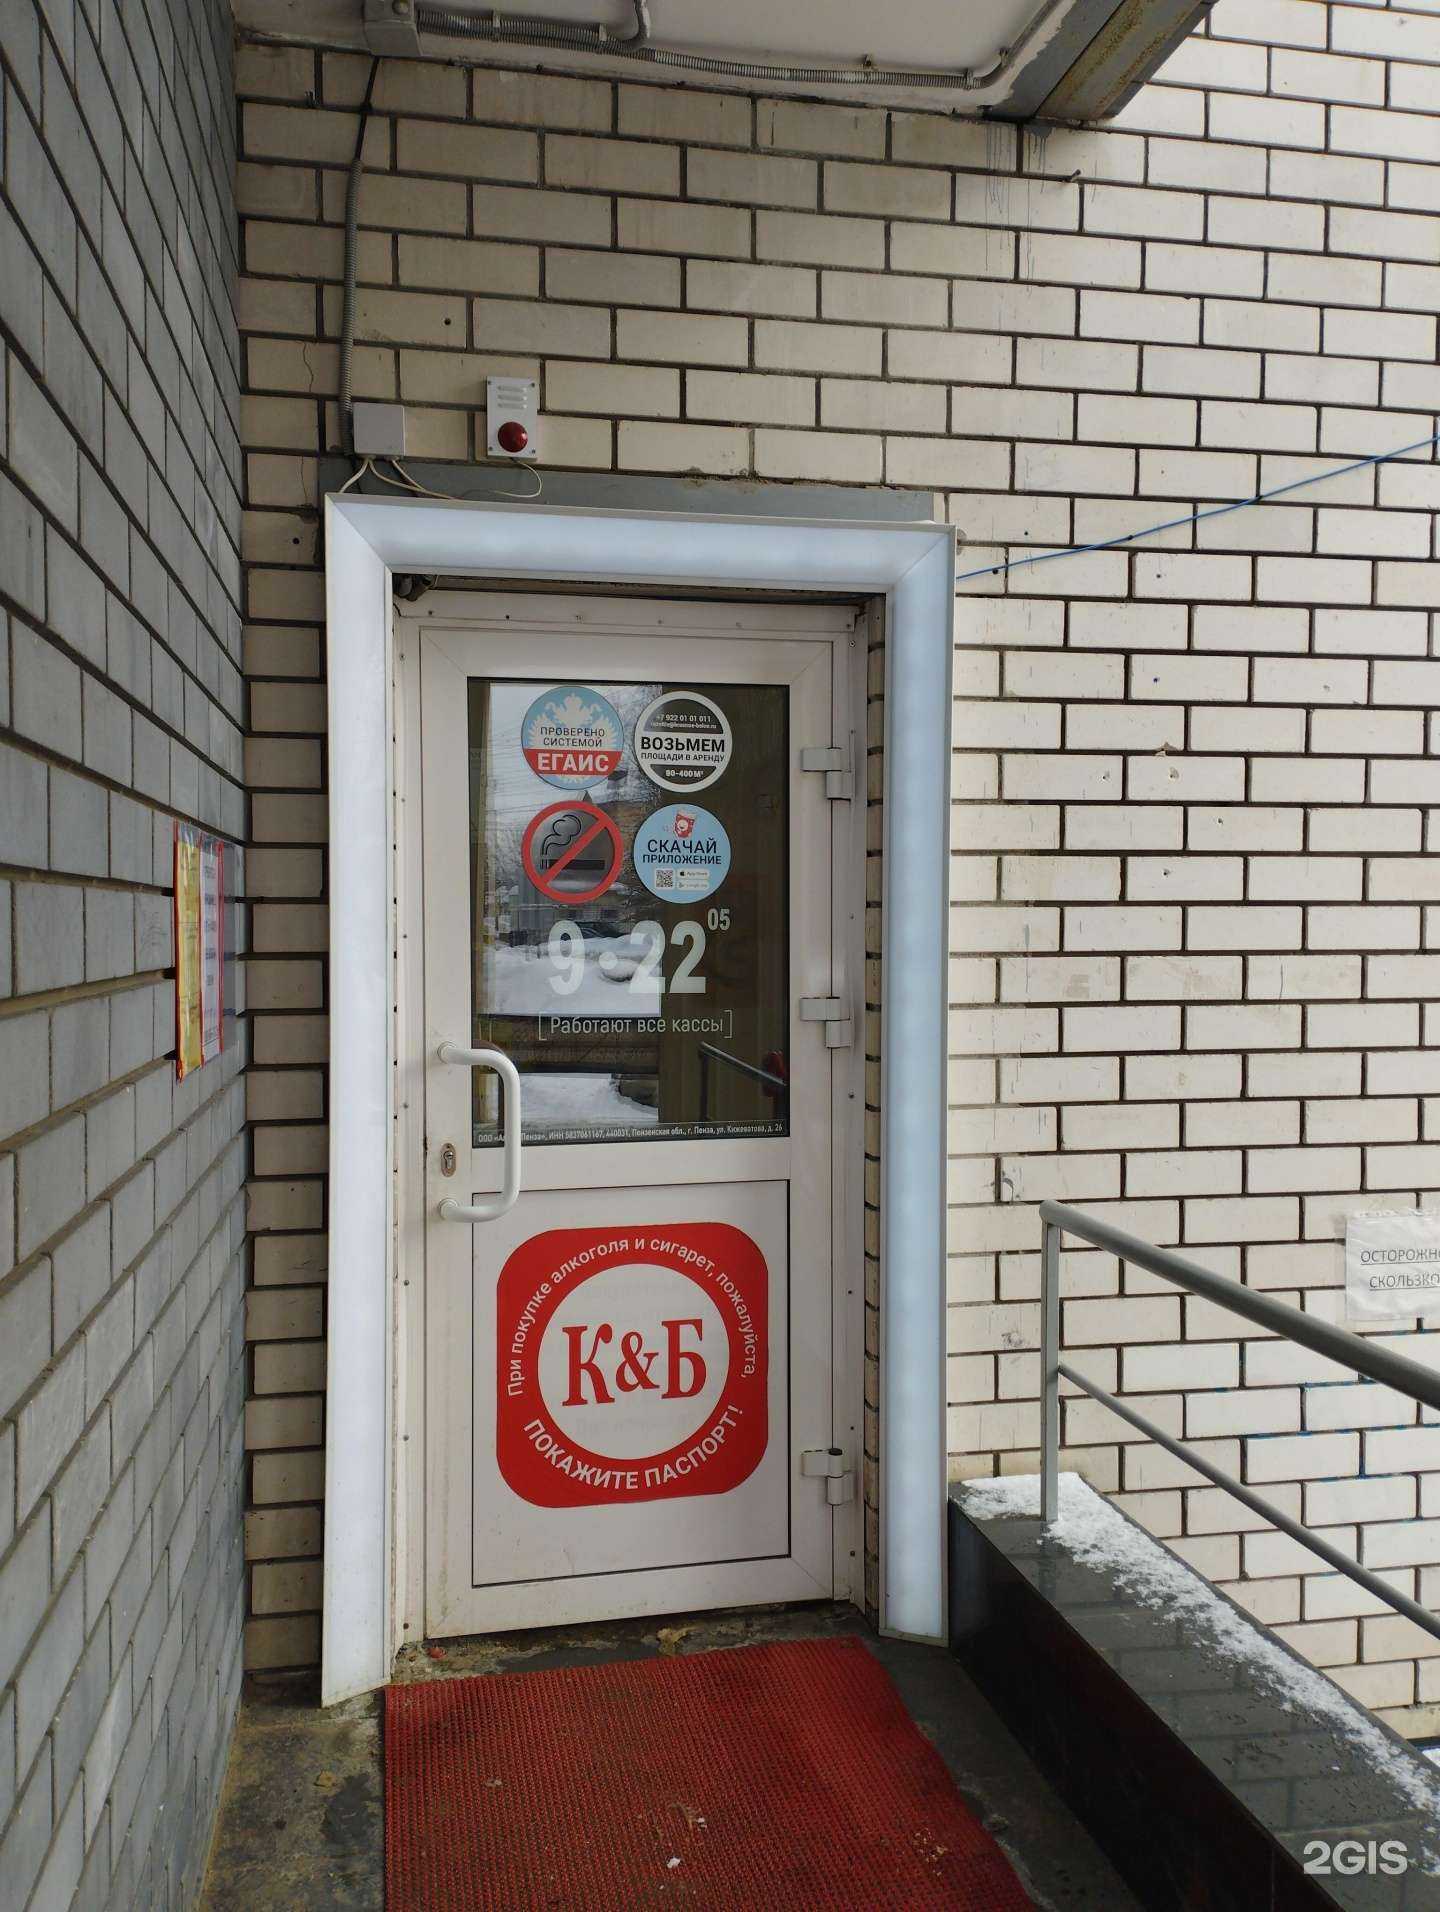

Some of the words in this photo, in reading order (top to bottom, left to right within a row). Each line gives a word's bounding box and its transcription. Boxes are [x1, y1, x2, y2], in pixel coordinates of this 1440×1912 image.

[666, 714, 678, 722] 922
[540, 726, 605, 737] ПРОВЕРЕНО
[543, 737, 602, 748] СИСТЕМОЙ
[640, 736, 725, 753] ВОЗЬМЕМ
[538, 753, 610, 772] ЕГАИС
[641, 752, 684, 762] ПЛОЩАДИ
[686, 752, 690, 761] В
[692, 753, 725, 763] АРЕНДУ
[647, 838, 718, 854] СКАЧАЙ
[642, 854, 722, 864] ПРИЛОЖЕНИЕ
[637, 1018, 666, 1033] все
[549, 1132, 563, 1140] ИНН
[634, 1238, 645, 1250] и
[552, 1238, 629, 1285] алкоголя
[650, 1238, 714, 1277] сигарет,
[511, 1283, 552, 1355] покупке
[716, 1272, 758, 1378] пожалуйста,
[562, 1318, 707, 1406] К&Б
[507, 1358, 525, 1396] При
[522, 1418, 639, 1489] ПОКАЖИТЕ
[644, 1403, 744, 1489] ПАСПОРТ!
